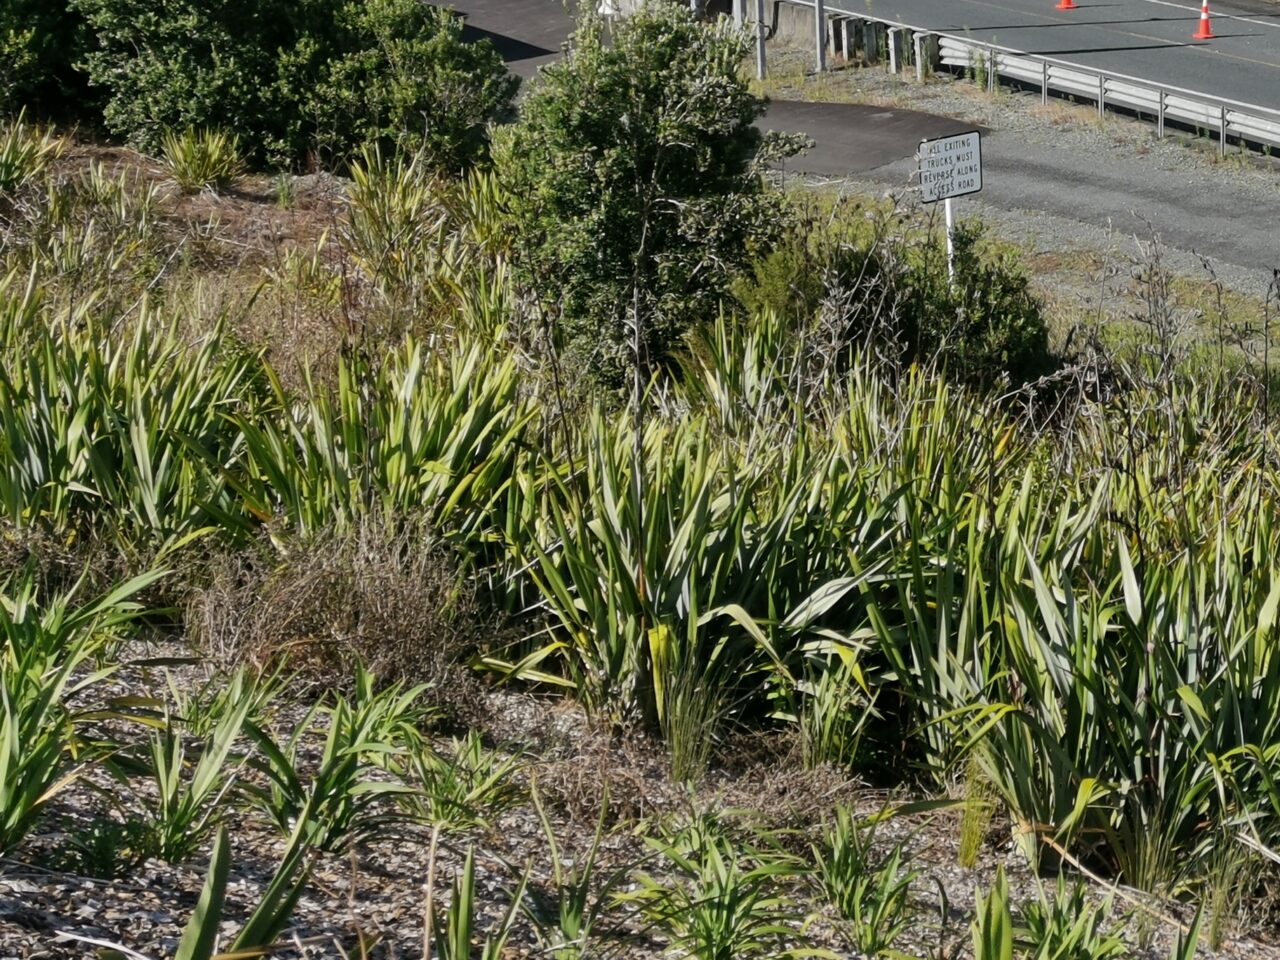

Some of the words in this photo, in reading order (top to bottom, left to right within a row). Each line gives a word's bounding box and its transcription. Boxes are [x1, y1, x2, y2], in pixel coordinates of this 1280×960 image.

[929, 144, 941, 154] ALL
[944, 138, 971, 152] EXITING
[927, 156, 952, 168] TRUCKS
[956, 151, 973, 162] MUST
[924, 169, 954, 183] REVERSE
[957, 164, 978, 176] ALONG
[958, 178, 975, 190] ROAD
